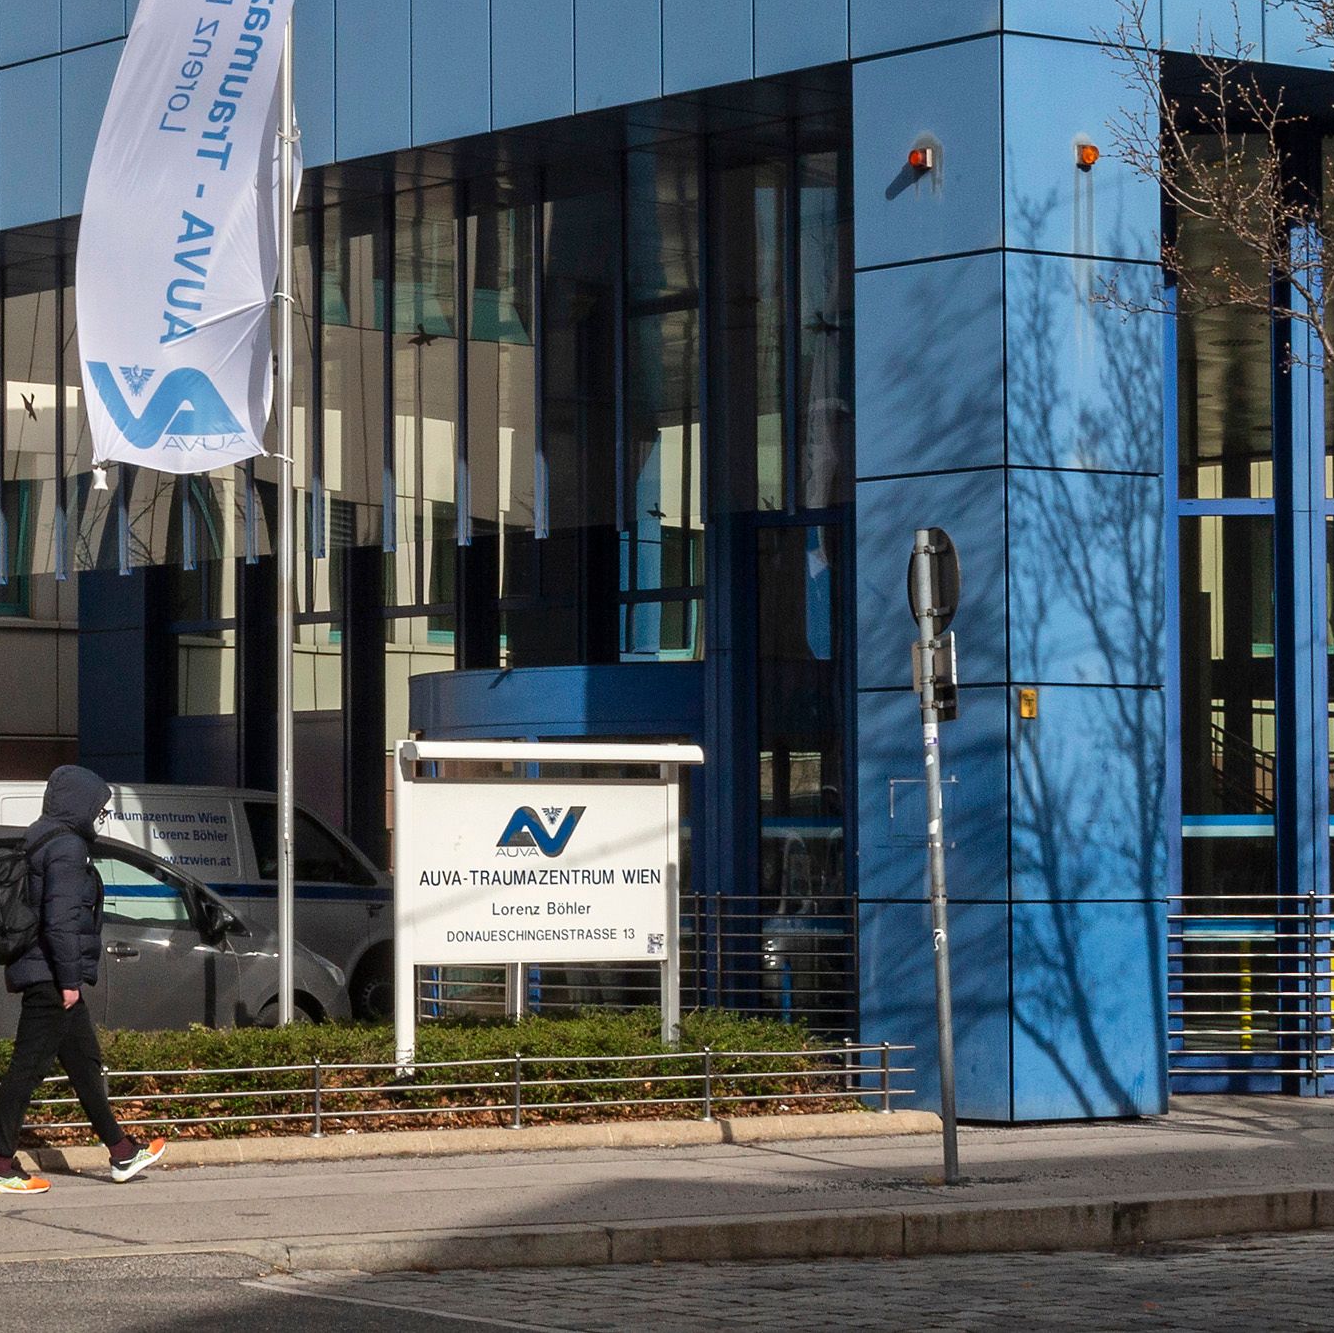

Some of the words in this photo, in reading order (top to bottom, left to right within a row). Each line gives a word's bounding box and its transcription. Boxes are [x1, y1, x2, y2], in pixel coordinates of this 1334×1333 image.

[108, 809, 196, 823] Traumazentrum
[198, 812, 227, 824] Wien
[153, 828, 189, 841] Lorenz
[193, 829, 228, 842] Böhler
[495, 847, 540, 858] AUVA
[419, 869, 615, 887] AUVA-TRAUMAZENTRUM
[622, 868, 661, 885] WIEN
[492, 902, 540, 916] Lorenz
[546, 901, 592, 916] Böhler
[446, 928, 617, 943] DONAUESCHINGENSTRASSE
[623, 928, 635, 940] 13
